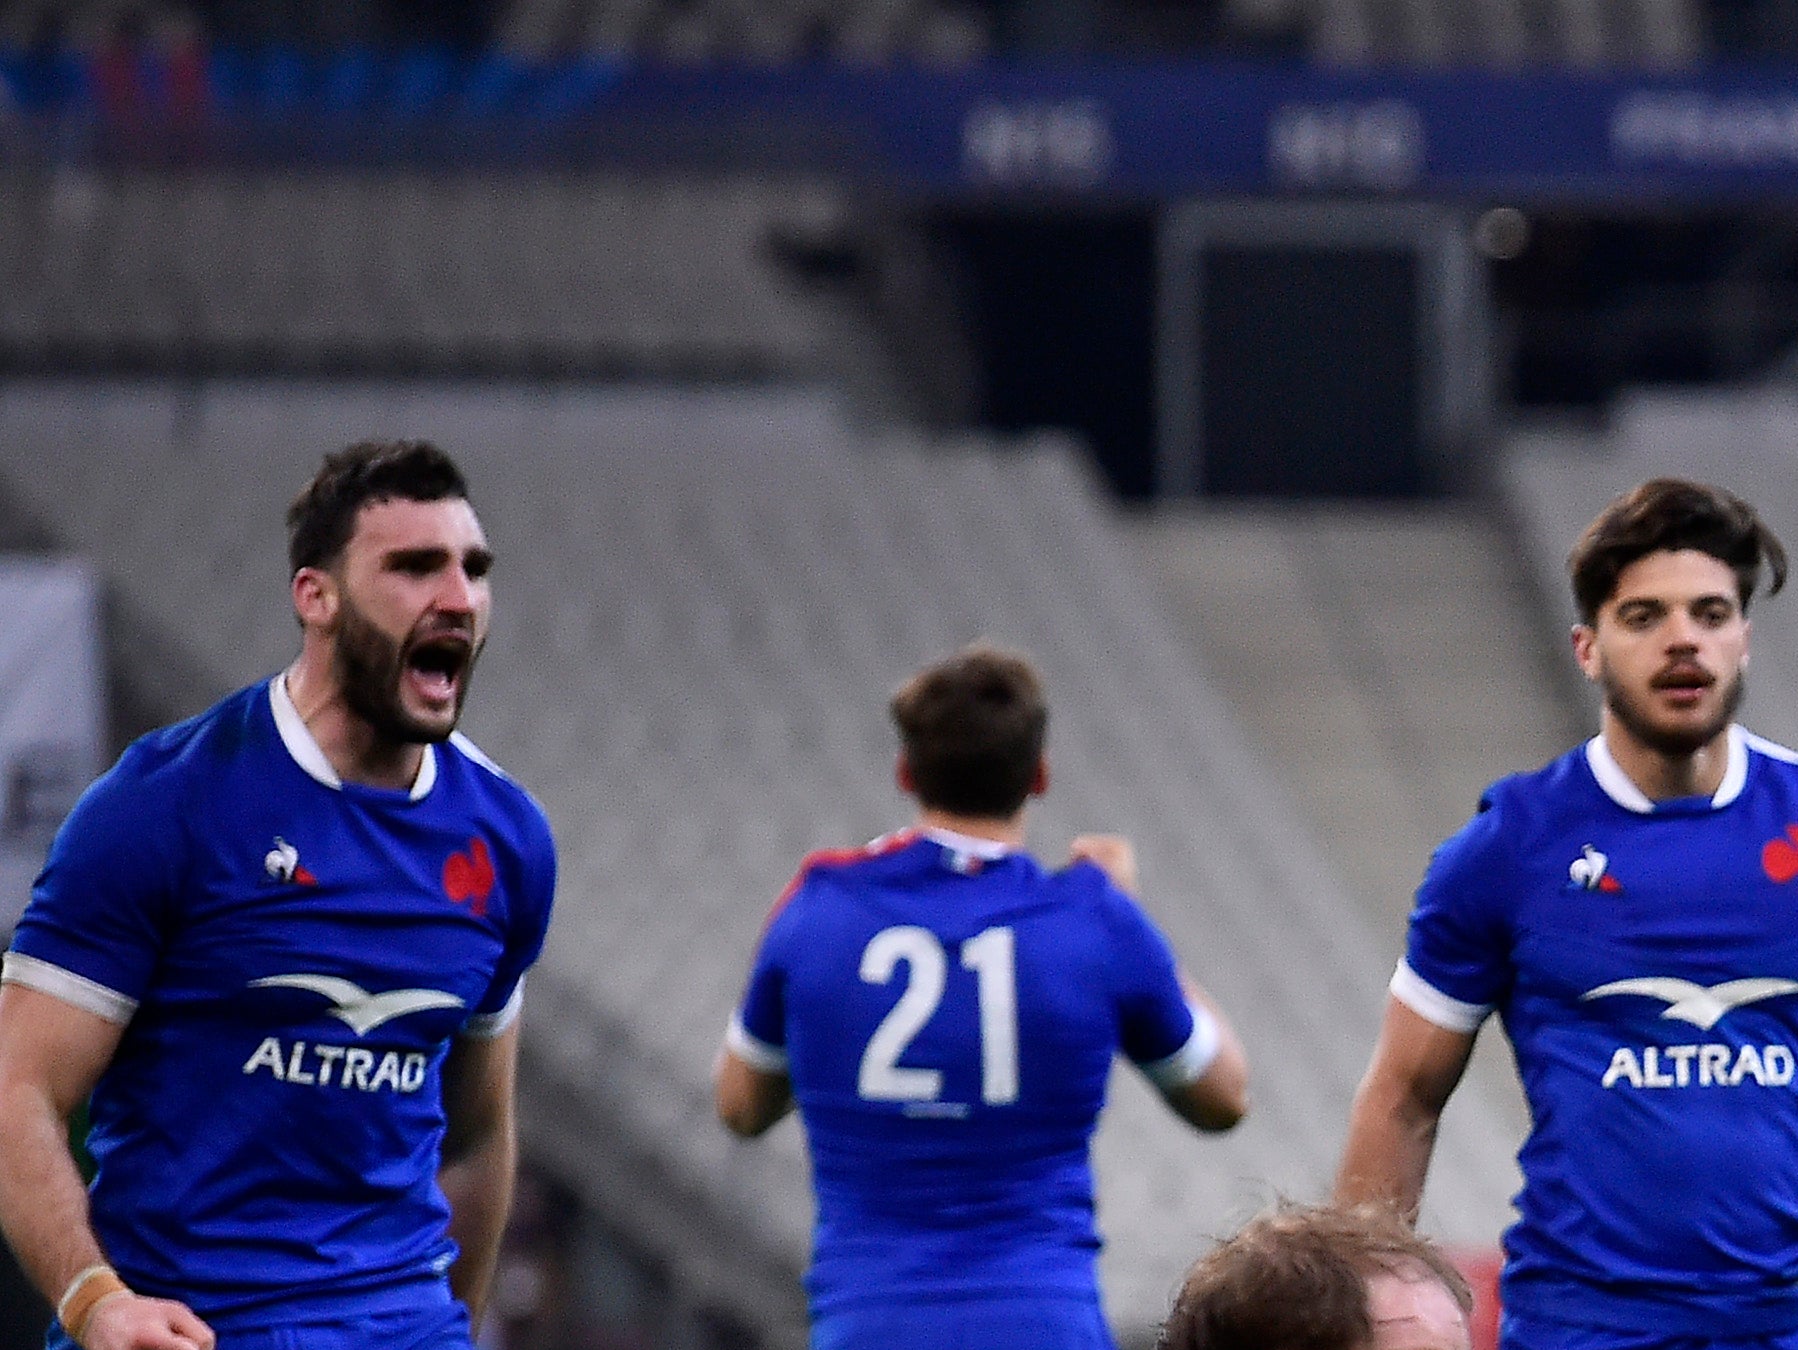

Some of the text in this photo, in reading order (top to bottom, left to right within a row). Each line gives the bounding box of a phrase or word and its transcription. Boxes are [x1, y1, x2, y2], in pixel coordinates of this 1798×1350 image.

[858, 925, 1019, 1106] 21
[243, 1036, 427, 1093] ALTRAD
[1602, 1044, 1796, 1088] ALTRAD
